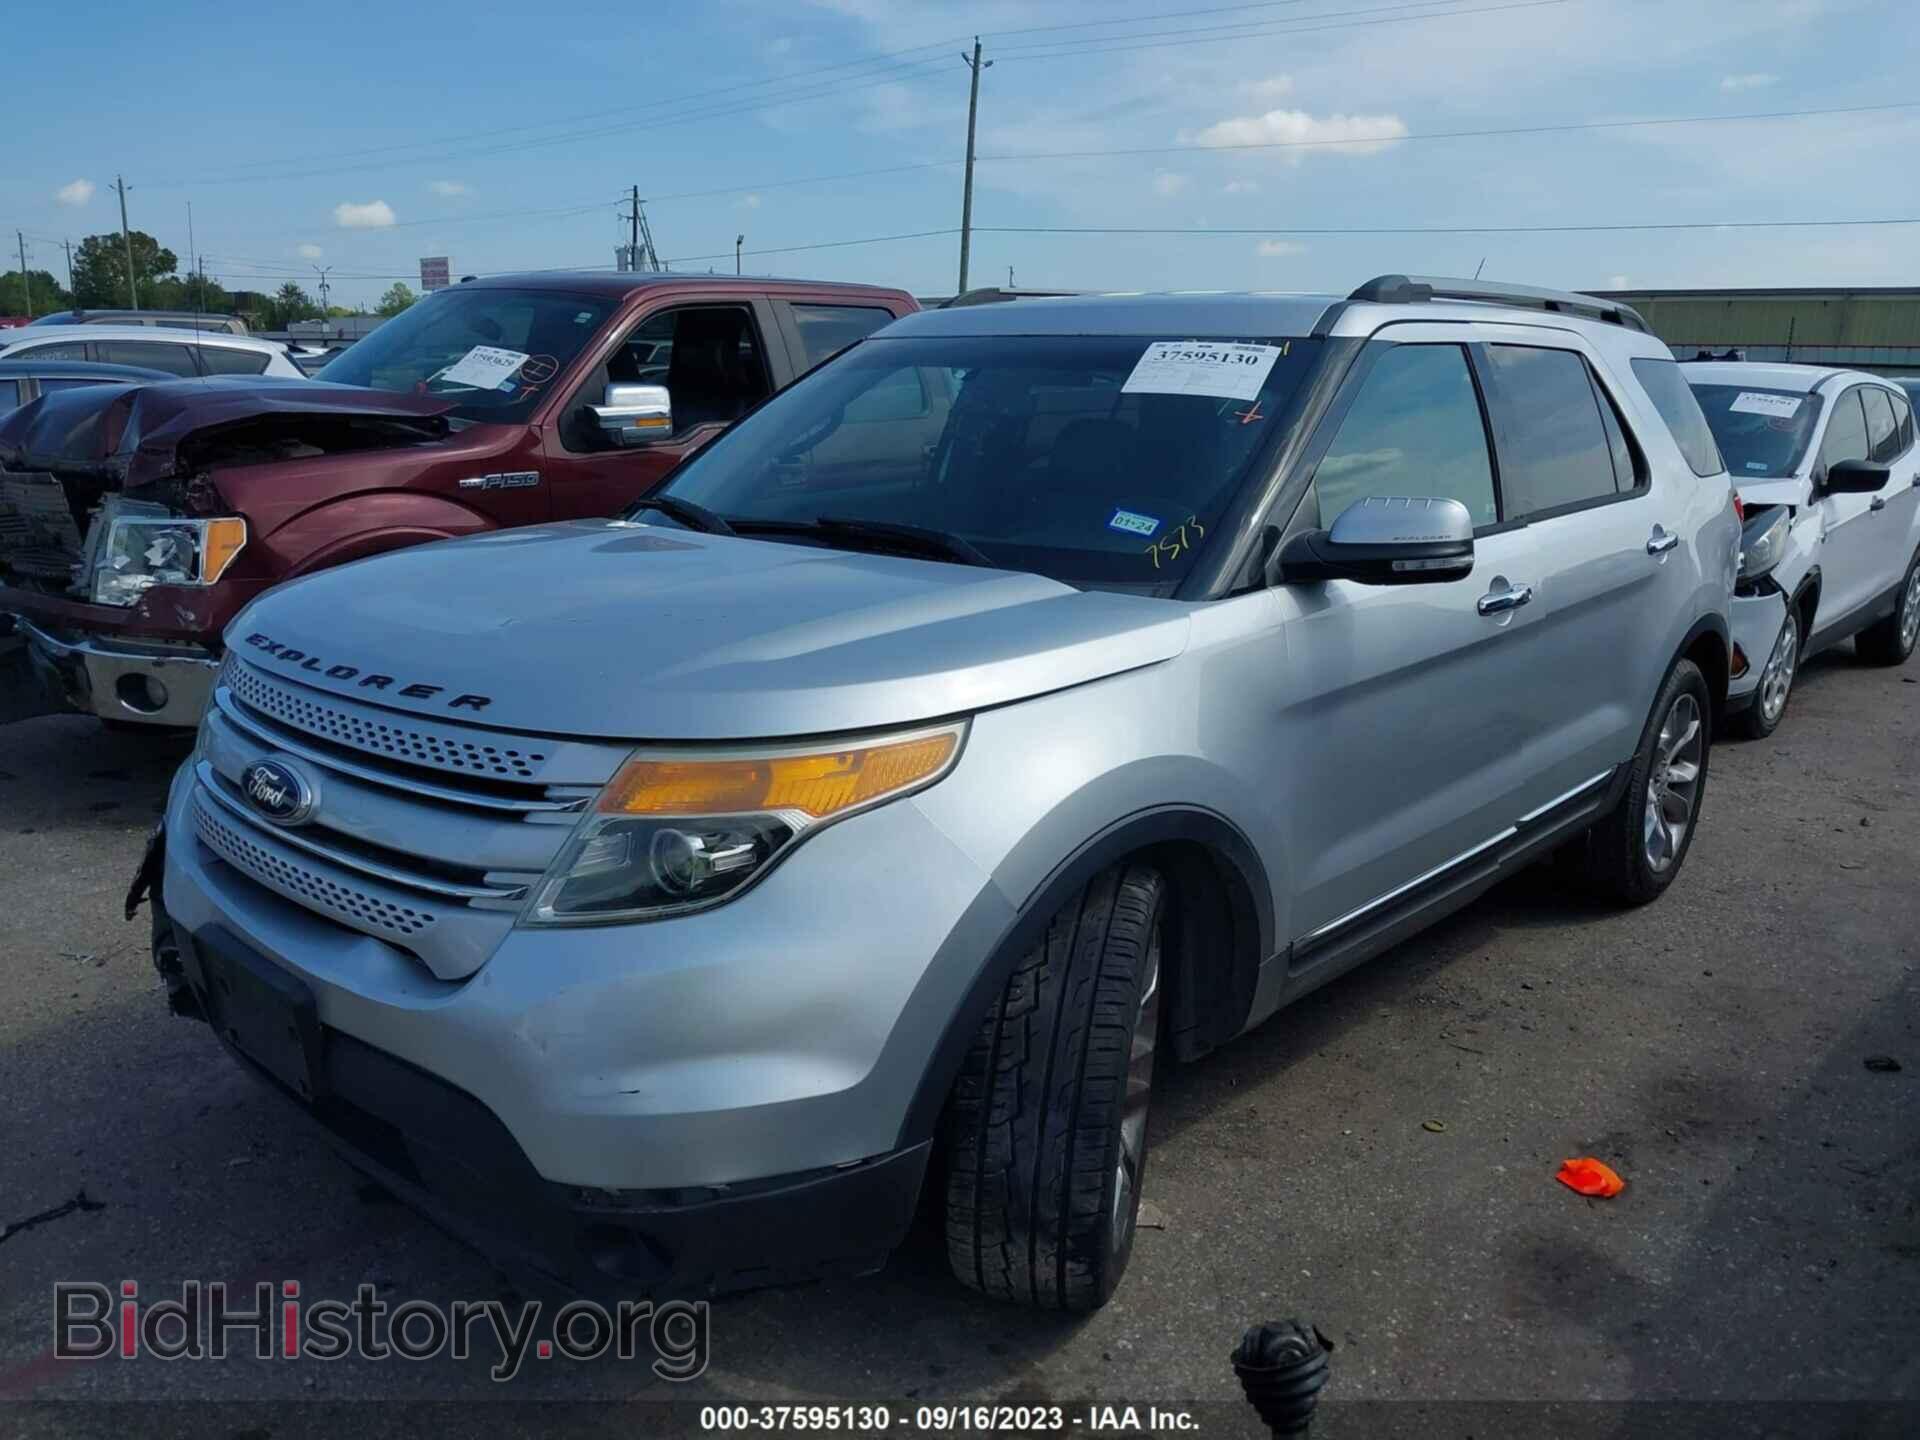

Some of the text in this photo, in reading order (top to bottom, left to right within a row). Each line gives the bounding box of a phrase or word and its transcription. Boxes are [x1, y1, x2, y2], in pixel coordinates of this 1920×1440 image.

[1153, 350, 1259, 366] 37595130
[244, 632, 492, 711] EXPLORER
[248, 766, 288, 808] Ford
